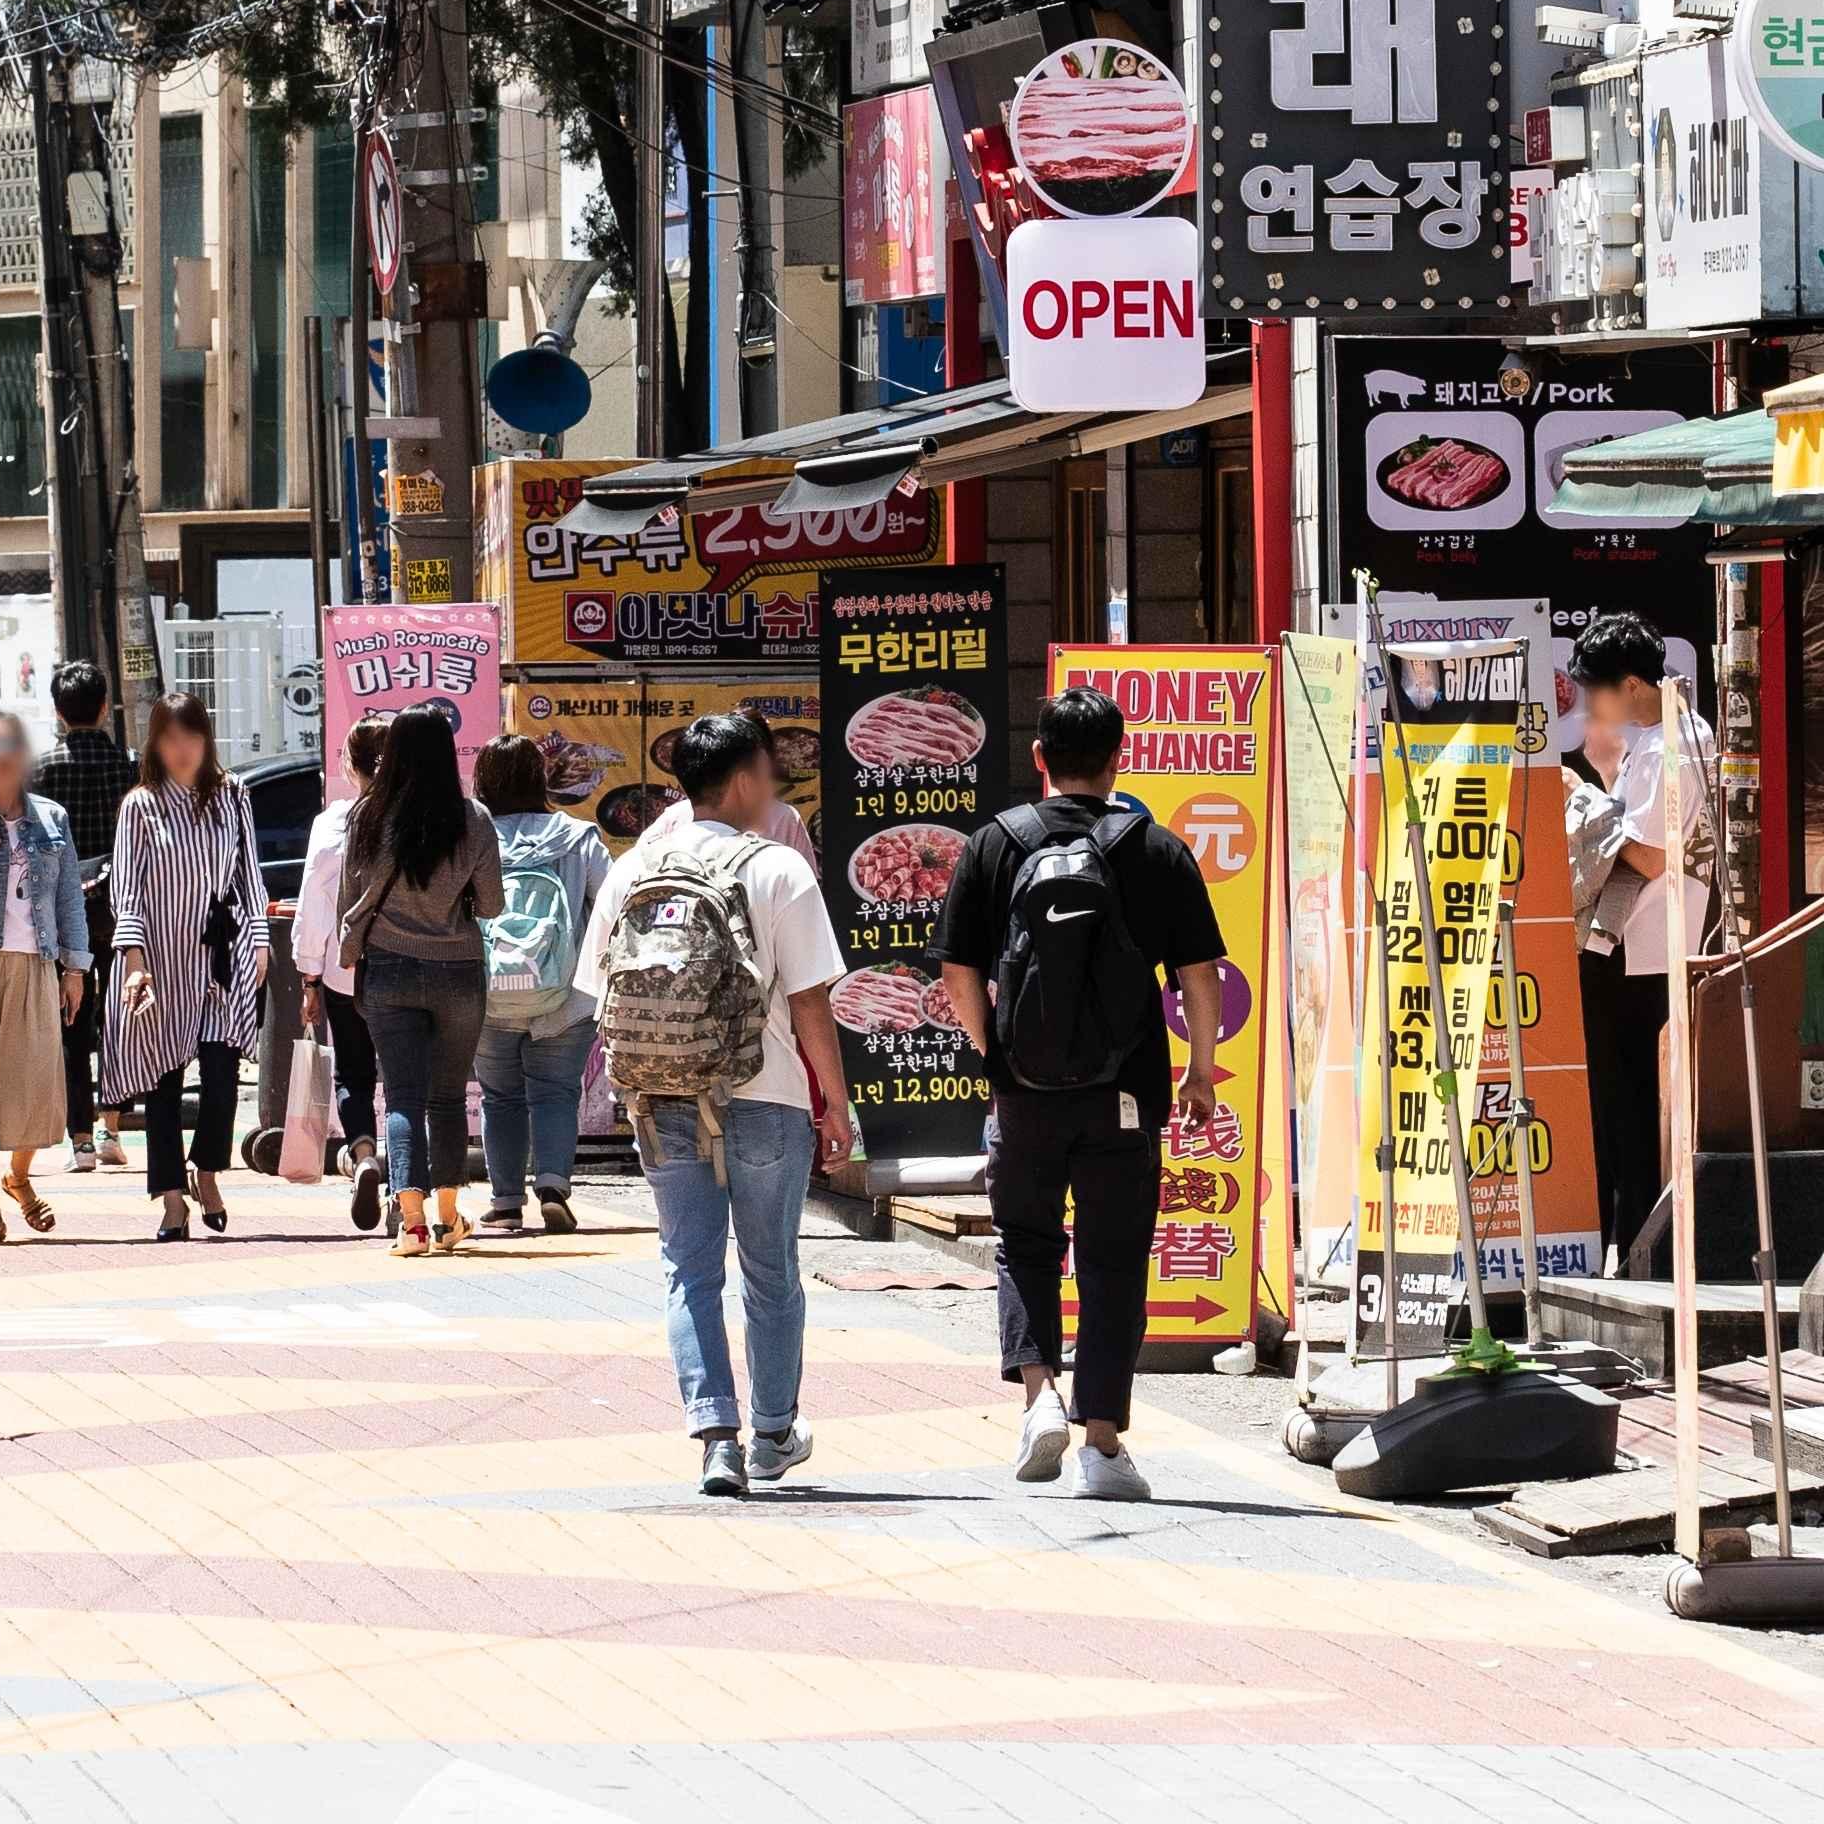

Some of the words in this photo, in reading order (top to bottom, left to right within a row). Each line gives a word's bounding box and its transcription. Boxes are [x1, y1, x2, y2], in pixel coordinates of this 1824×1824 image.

[1239, 157, 1490, 256] 연습장
[1021, 279, 1195, 341] OPEN
[1548, 382, 1615, 404] Pork
[1553, 605, 1598, 626] eef
[333, 633, 389, 660] Mush
[838, 628, 988, 674] 무한리필
[346, 651, 479, 695] 머쉬룸
[1114, 732, 1257, 776] CHANGE
[854, 767, 906, 787] 삼겹살
[910, 763, 978, 785] 무한리필
[855, 794, 885, 817] 1인
[894, 789, 978, 816] 9,900원
[1184, 805, 1249, 871] 元
[849, 929, 881, 951] 1인
[887, 1051, 957, 1073] 무한리필
[853, 1081, 885, 1105] 1인
[893, 1075, 991, 1104] 12,900원
